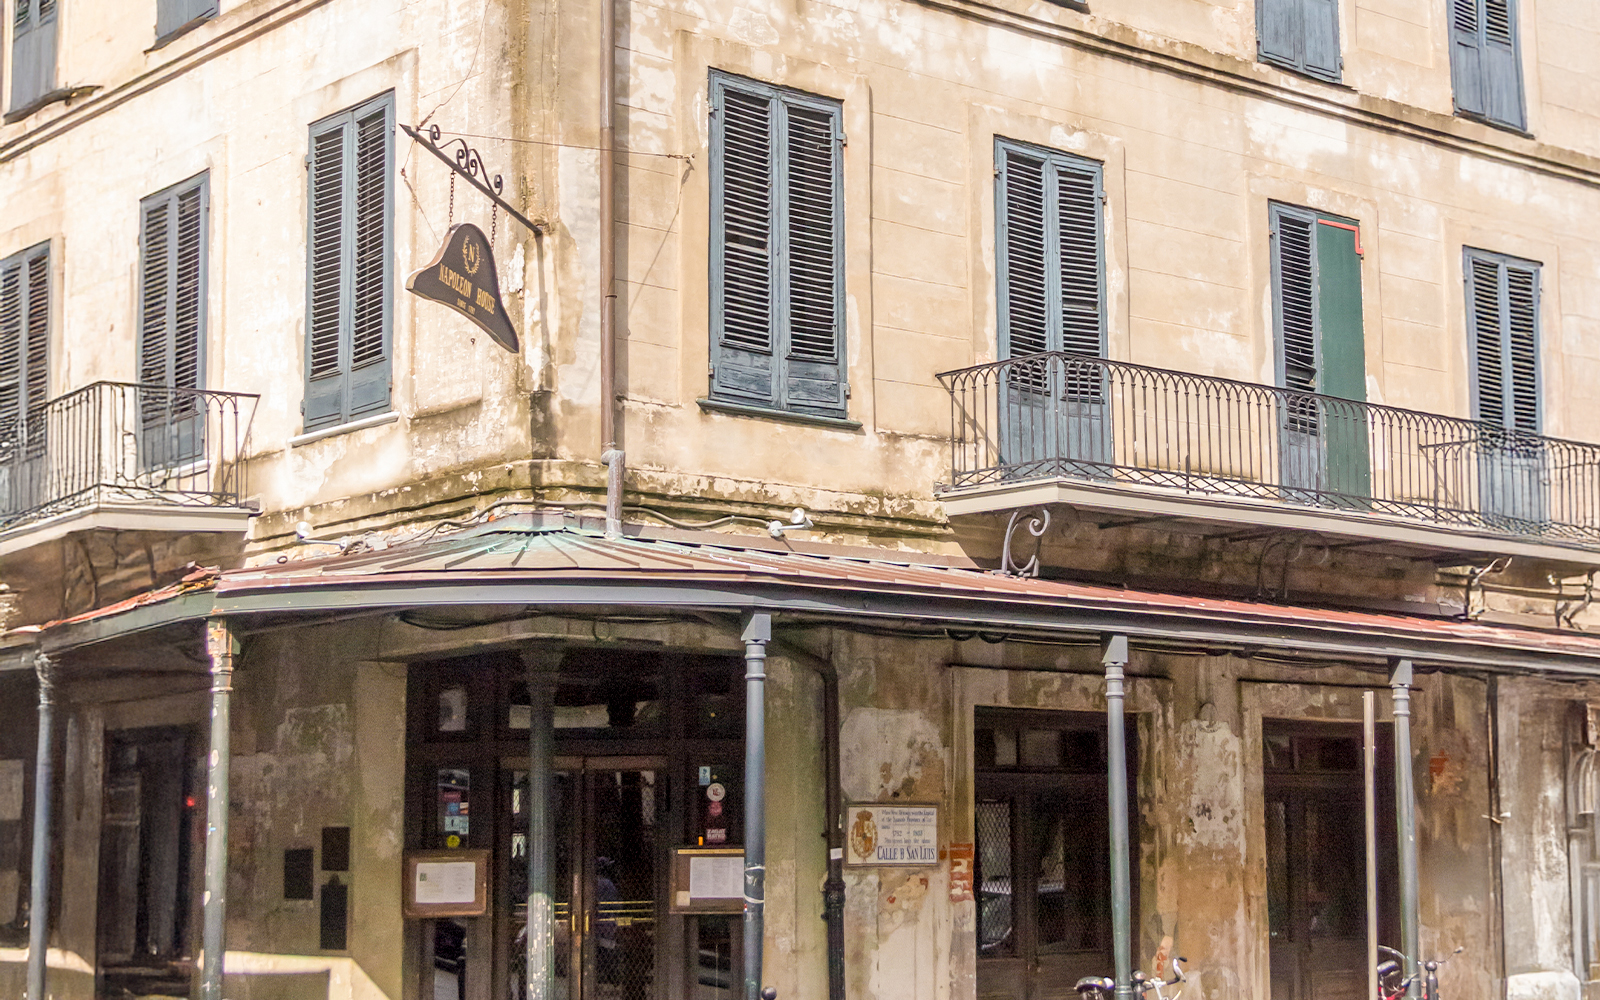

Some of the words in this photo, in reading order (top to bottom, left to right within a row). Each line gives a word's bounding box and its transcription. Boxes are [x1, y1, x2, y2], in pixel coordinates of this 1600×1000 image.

[468, 244, 475, 262] N
[439, 262, 472, 298] NAPOLEON
[476, 288, 495, 314] HOUSE
[878, 846, 898, 860] CALLE
[906, 846, 919, 860] SAN
[920, 846, 935, 860] LUIS
